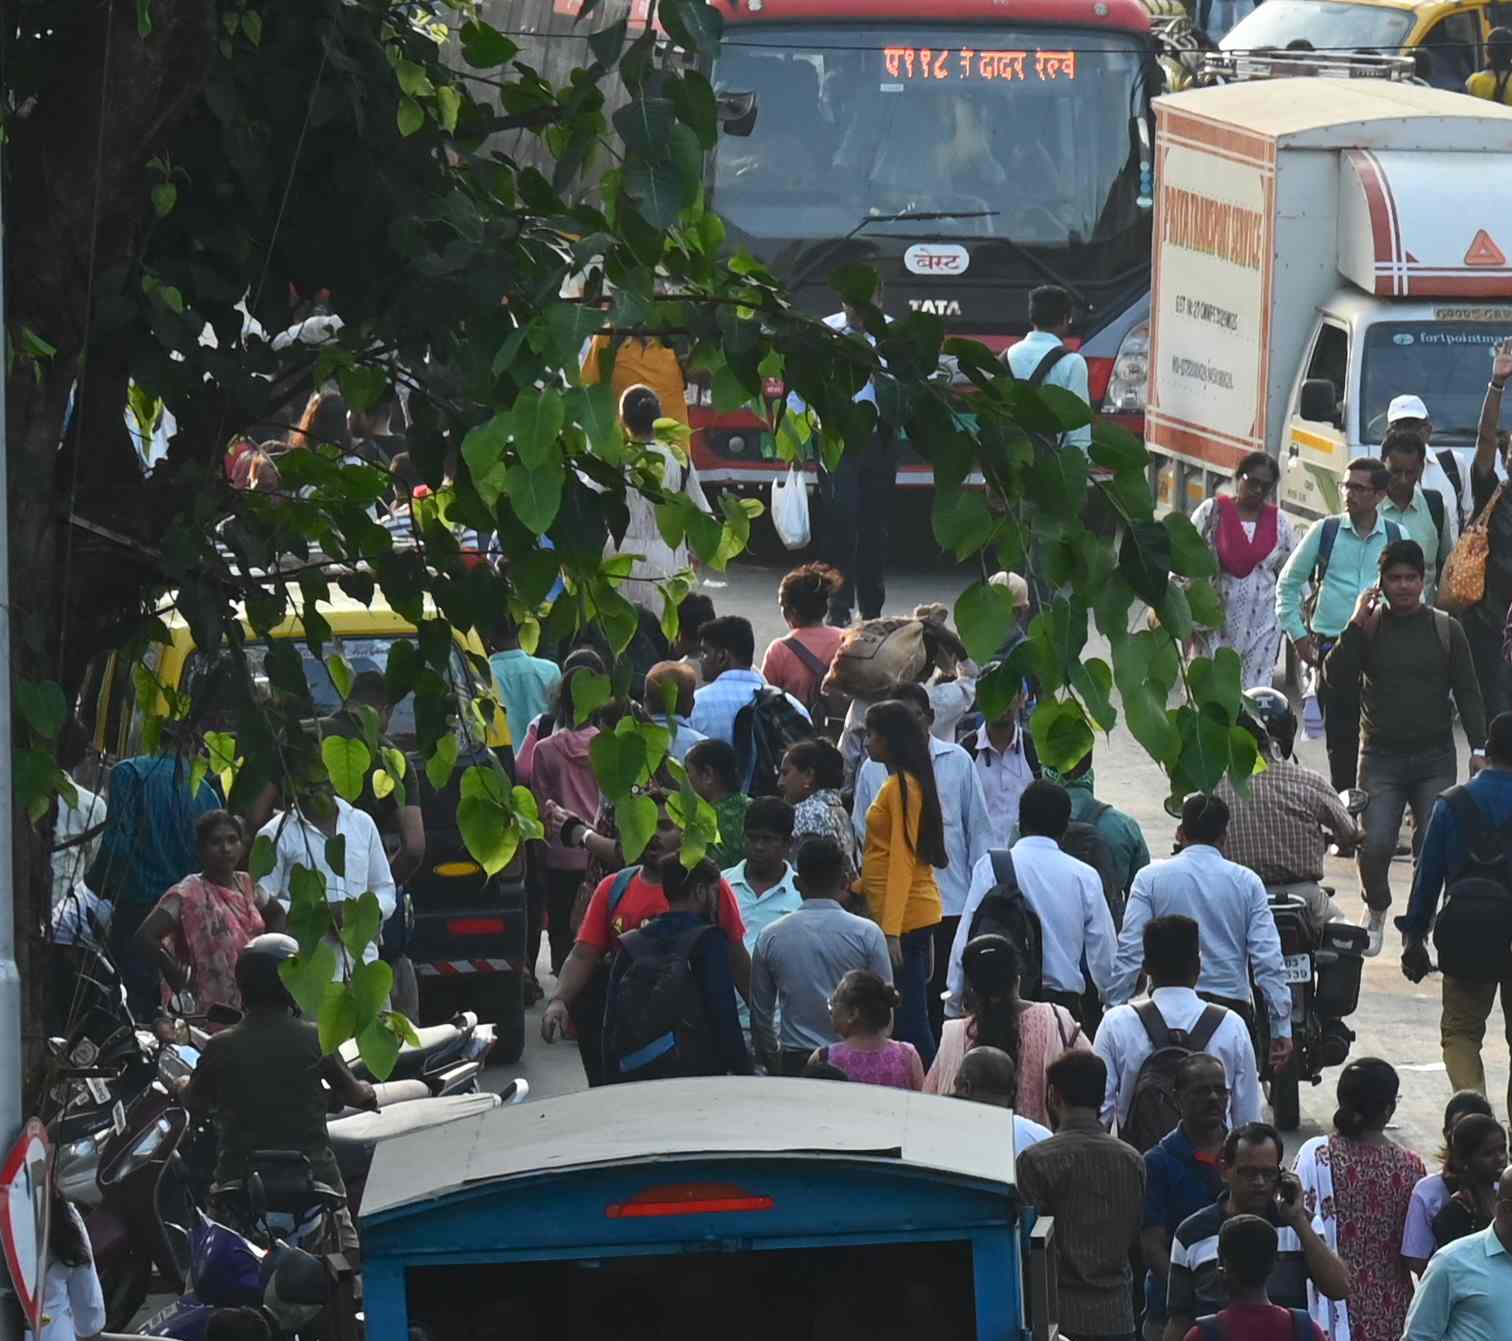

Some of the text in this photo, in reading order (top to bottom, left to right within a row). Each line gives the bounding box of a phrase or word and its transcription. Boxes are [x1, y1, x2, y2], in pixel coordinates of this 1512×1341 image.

[980, 50, 1026, 80] दादर
[914, 247, 960, 270] बेस्ट
[909, 300, 961, 315] TATA
